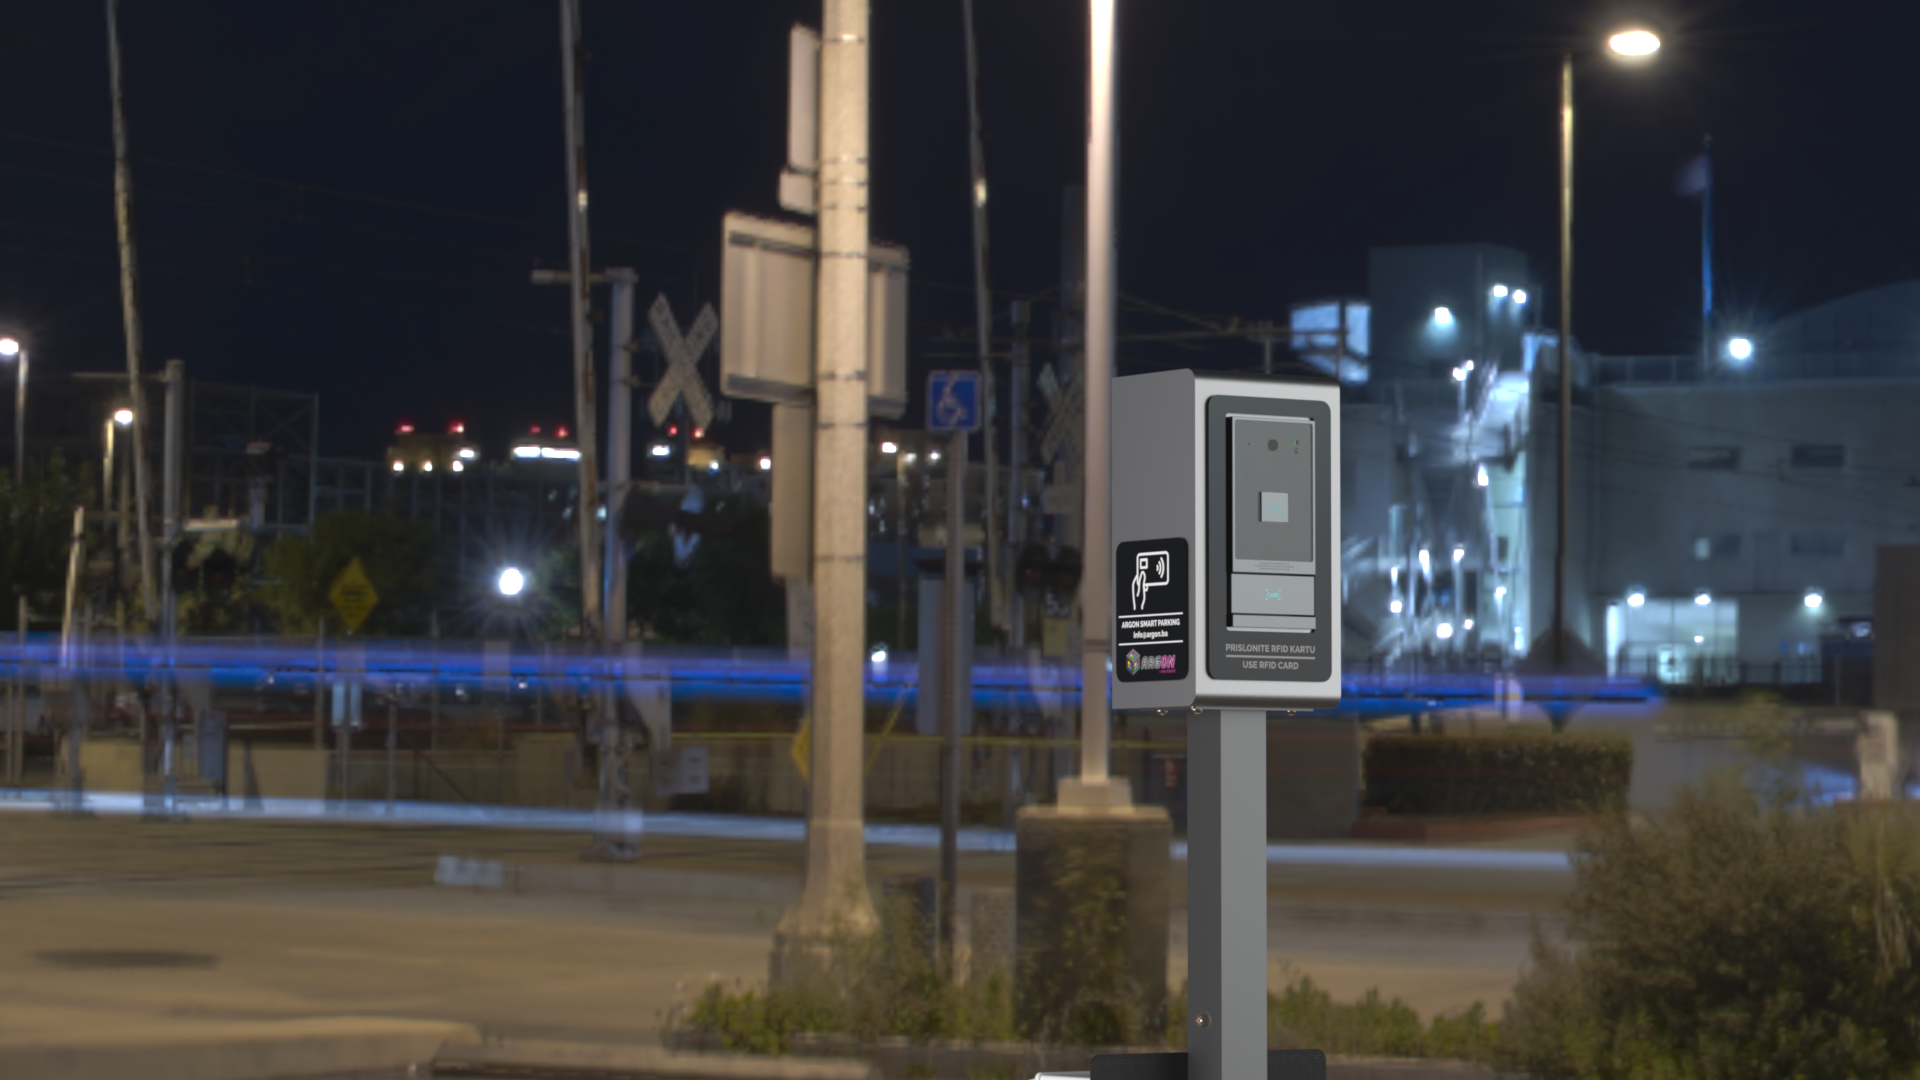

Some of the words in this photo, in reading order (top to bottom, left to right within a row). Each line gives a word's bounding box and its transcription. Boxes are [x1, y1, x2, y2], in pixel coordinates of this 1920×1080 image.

[1121, 620, 1139, 629] ARGON
[1140, 619, 1157, 628] SMART
[1158, 618, 1180, 627] PARKING
[1132, 629, 1168, 640] info@argon.ba
[1225, 643, 1270, 653] PRISLONITE
[1271, 644, 1289, 653] RFID
[1290, 645, 1316, 654] KARTU
[1141, 654, 1176, 670] ARGON
[1242, 660, 1258, 669] USE
[1259, 661, 1276, 669] RFID
[1277, 661, 1299, 670] CARD
